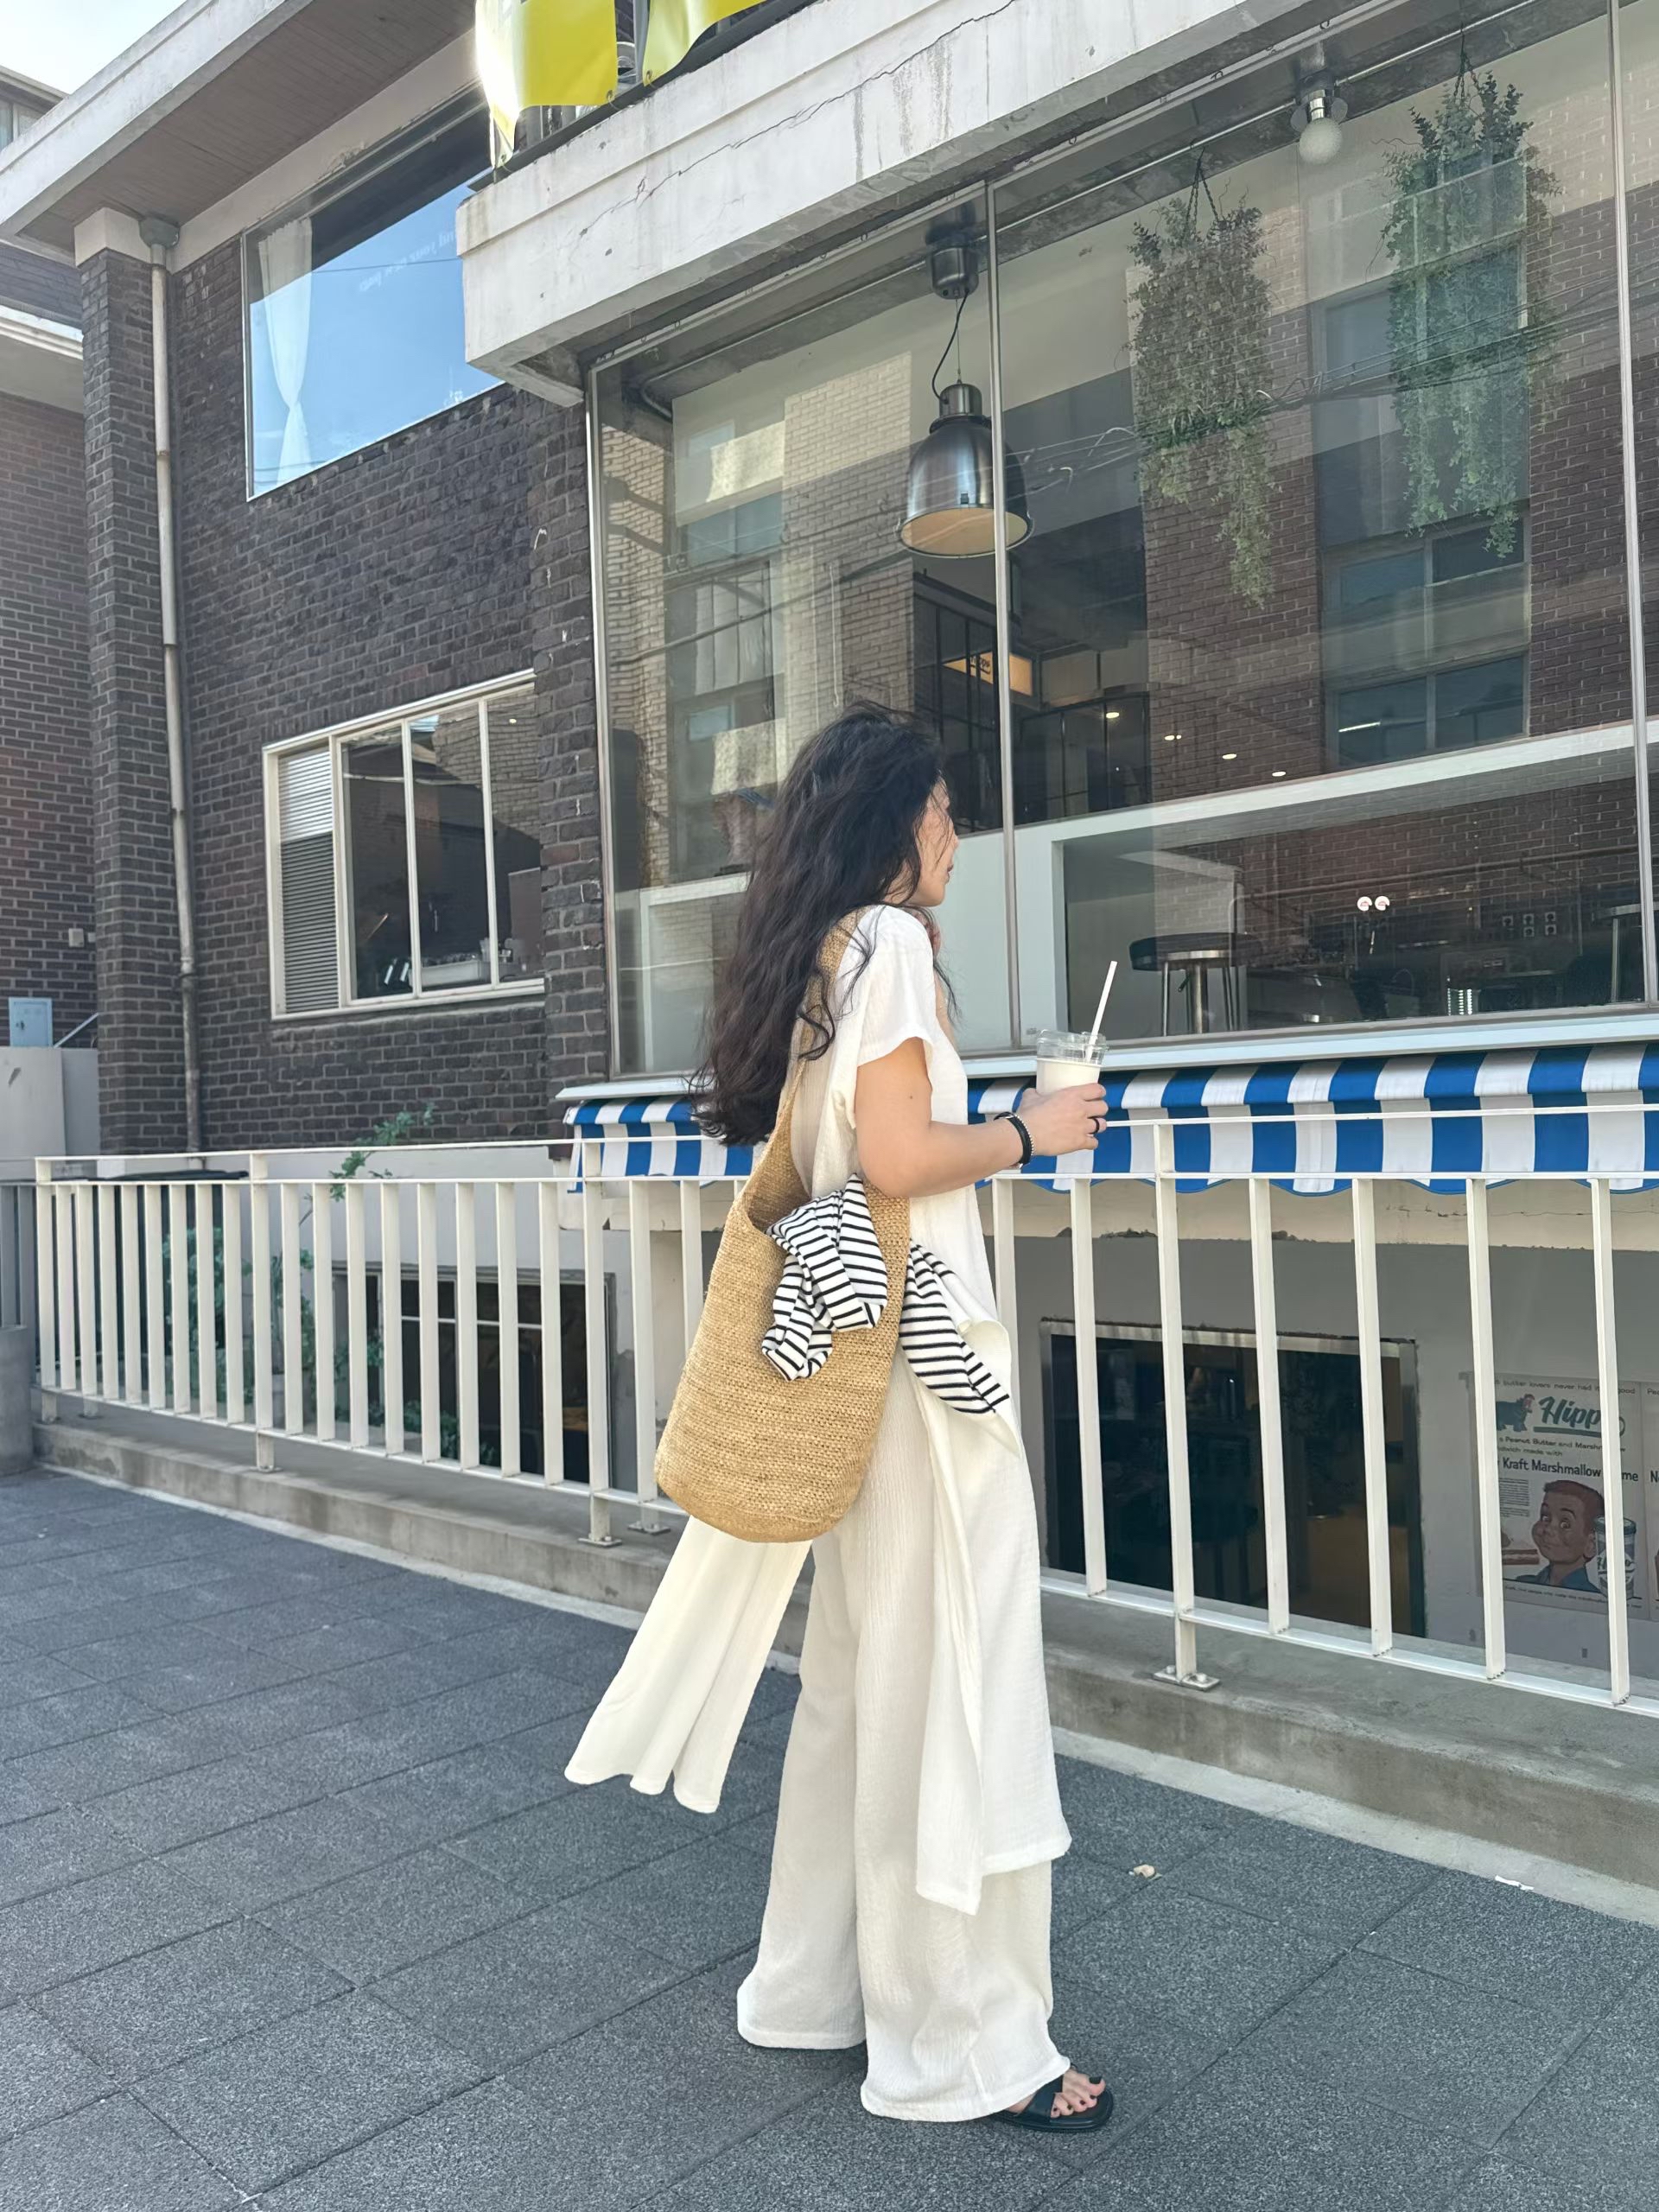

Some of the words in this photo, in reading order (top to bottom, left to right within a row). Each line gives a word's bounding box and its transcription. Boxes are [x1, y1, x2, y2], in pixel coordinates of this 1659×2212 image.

[1505, 1436, 1530, 1445] Peanut
[1534, 1438, 1557, 1447] Butter
[1503, 1457, 1529, 1471] Kraft
[1531, 1459, 1602, 1478] Marshmallow
